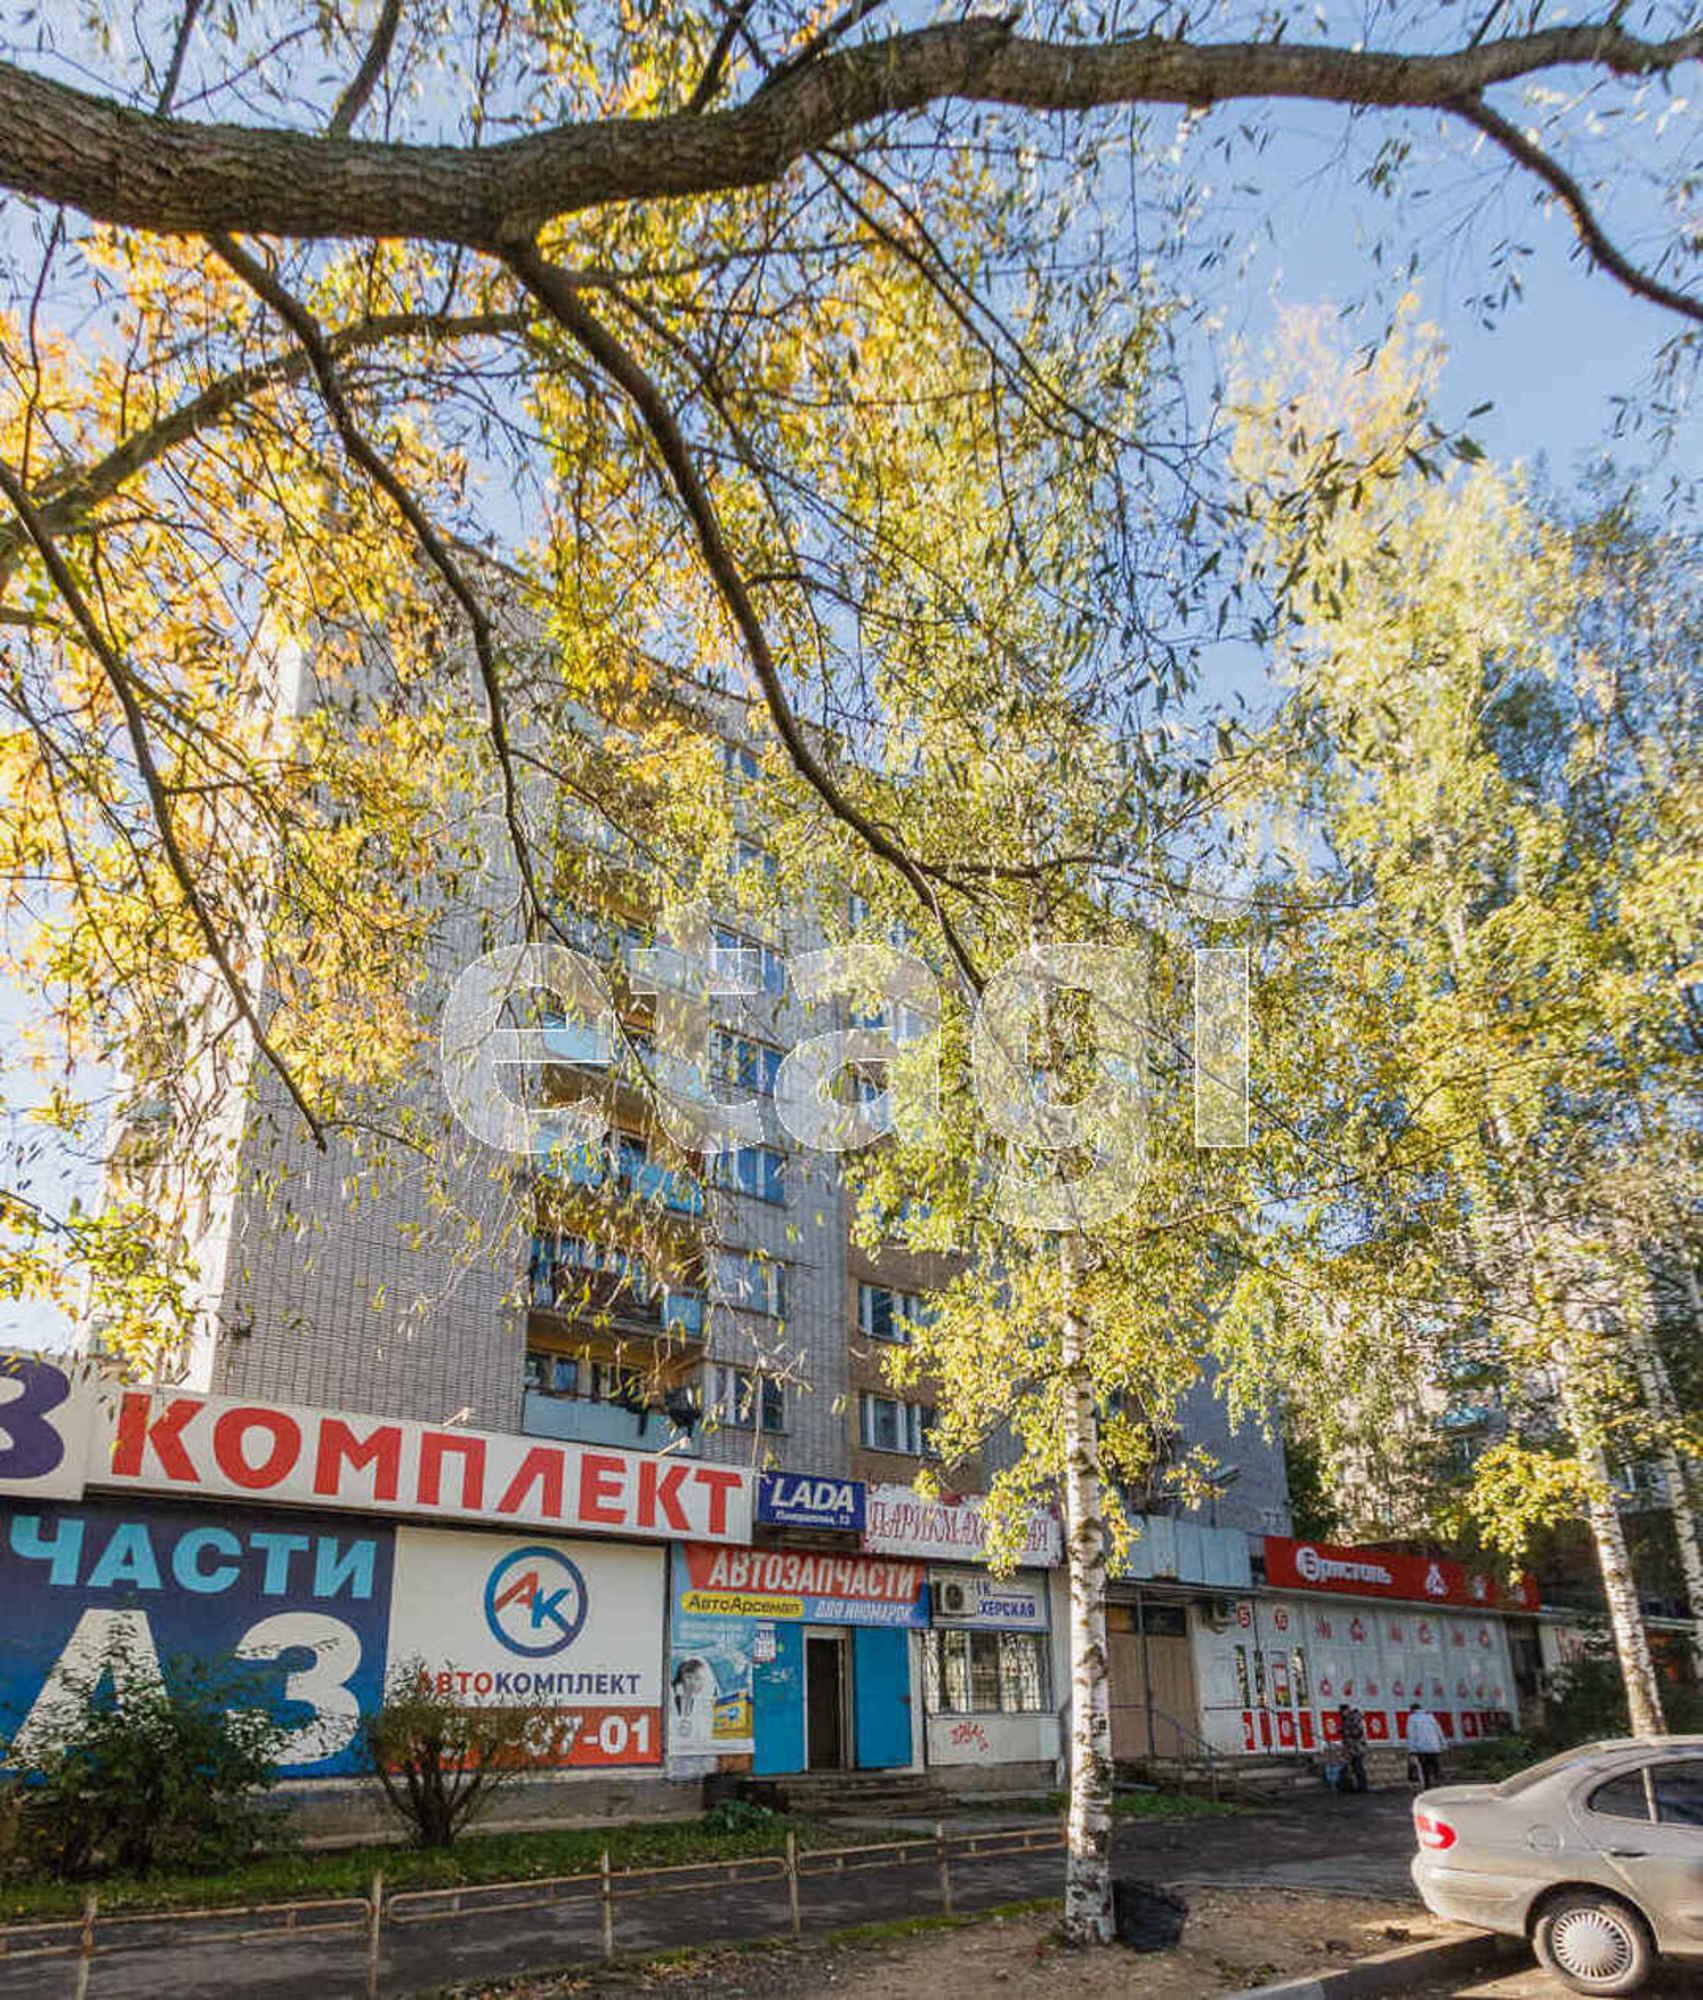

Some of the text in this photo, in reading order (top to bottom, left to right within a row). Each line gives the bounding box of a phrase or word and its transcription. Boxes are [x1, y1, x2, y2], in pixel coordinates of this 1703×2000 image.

[111, 1393, 742, 1535] КОМПЛЕКТ
[770, 1478, 855, 1513] LADA
[9, 1515, 377, 1599] ЧАСТИ
[708, 1551, 917, 1600] АВТОЗАПЧАСТИ
